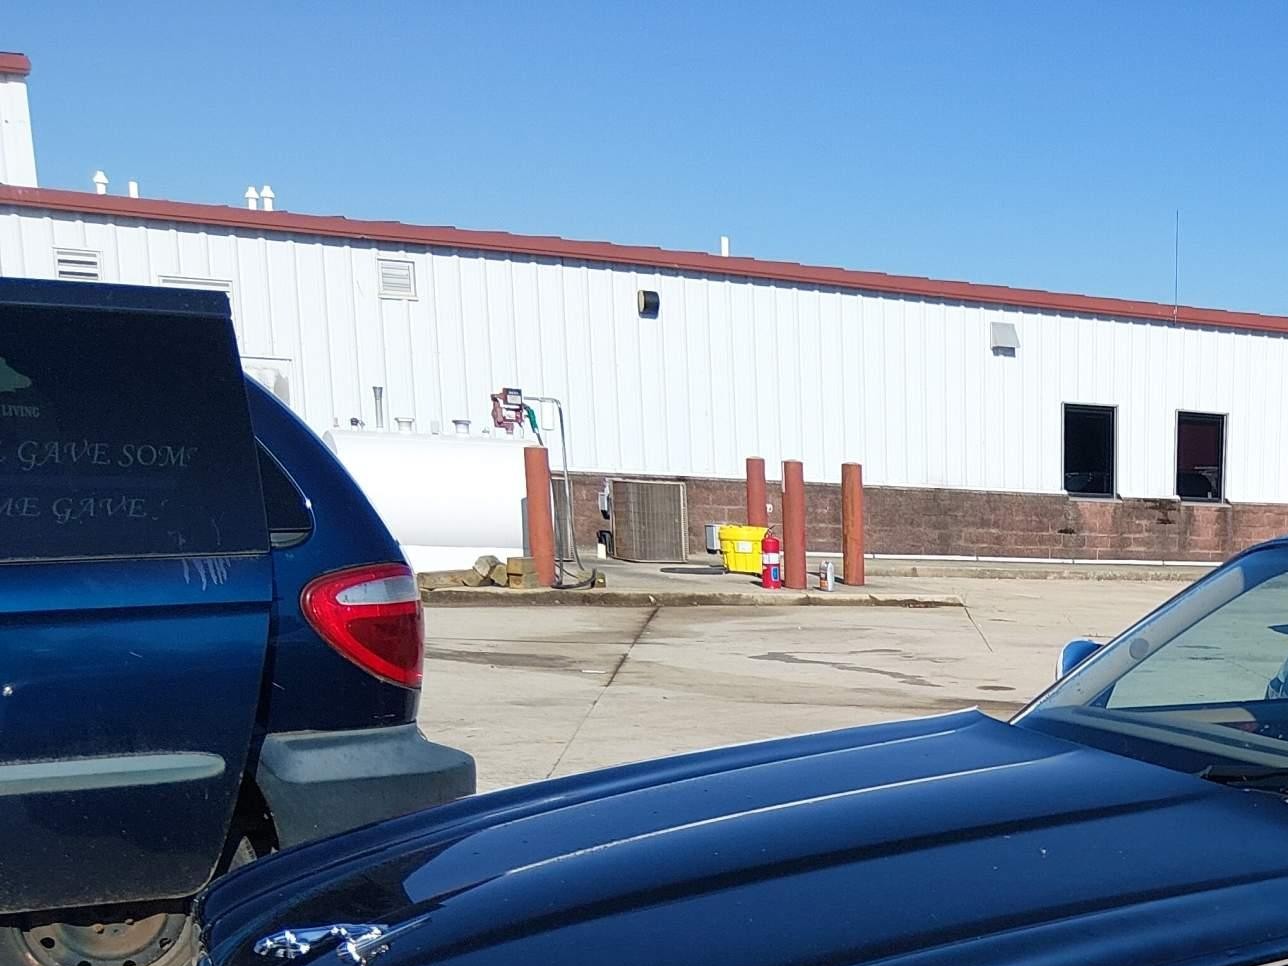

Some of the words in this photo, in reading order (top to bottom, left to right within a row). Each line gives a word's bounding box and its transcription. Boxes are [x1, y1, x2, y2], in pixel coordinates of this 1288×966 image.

[17, 440, 111, 471] GAVE
[118, 443, 198, 467] SOM
[52, 495, 147, 523] GAVE
